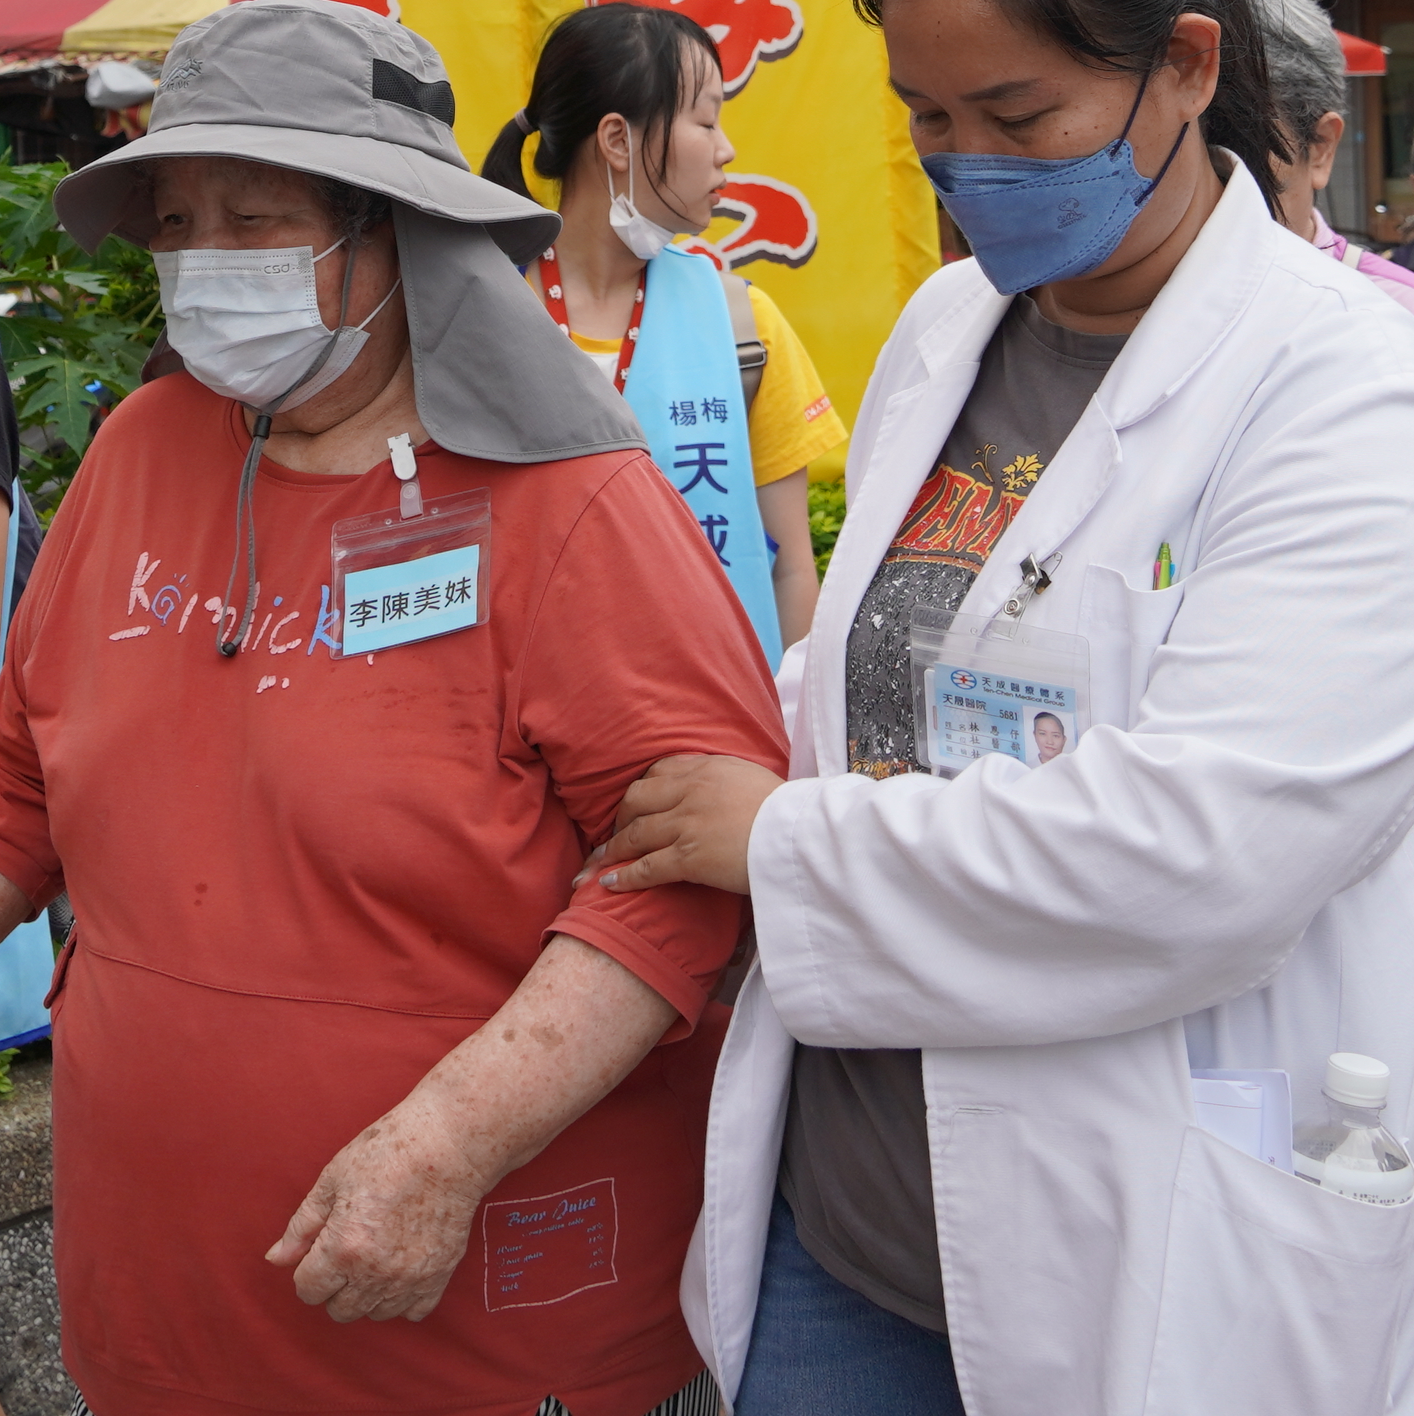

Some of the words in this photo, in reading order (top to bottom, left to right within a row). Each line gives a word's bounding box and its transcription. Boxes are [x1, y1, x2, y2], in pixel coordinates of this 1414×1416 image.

[263, 263, 291, 275] csd
[668, 396, 729, 427] 楊梅
[348, 574, 473, 630] 李陳美妹
[1014, 693, 1043, 704] Medical
[1043, 698, 1066, 708] Group
[998, 709, 1019, 722] 5681
[551, 1196, 597, 1221] Juice
